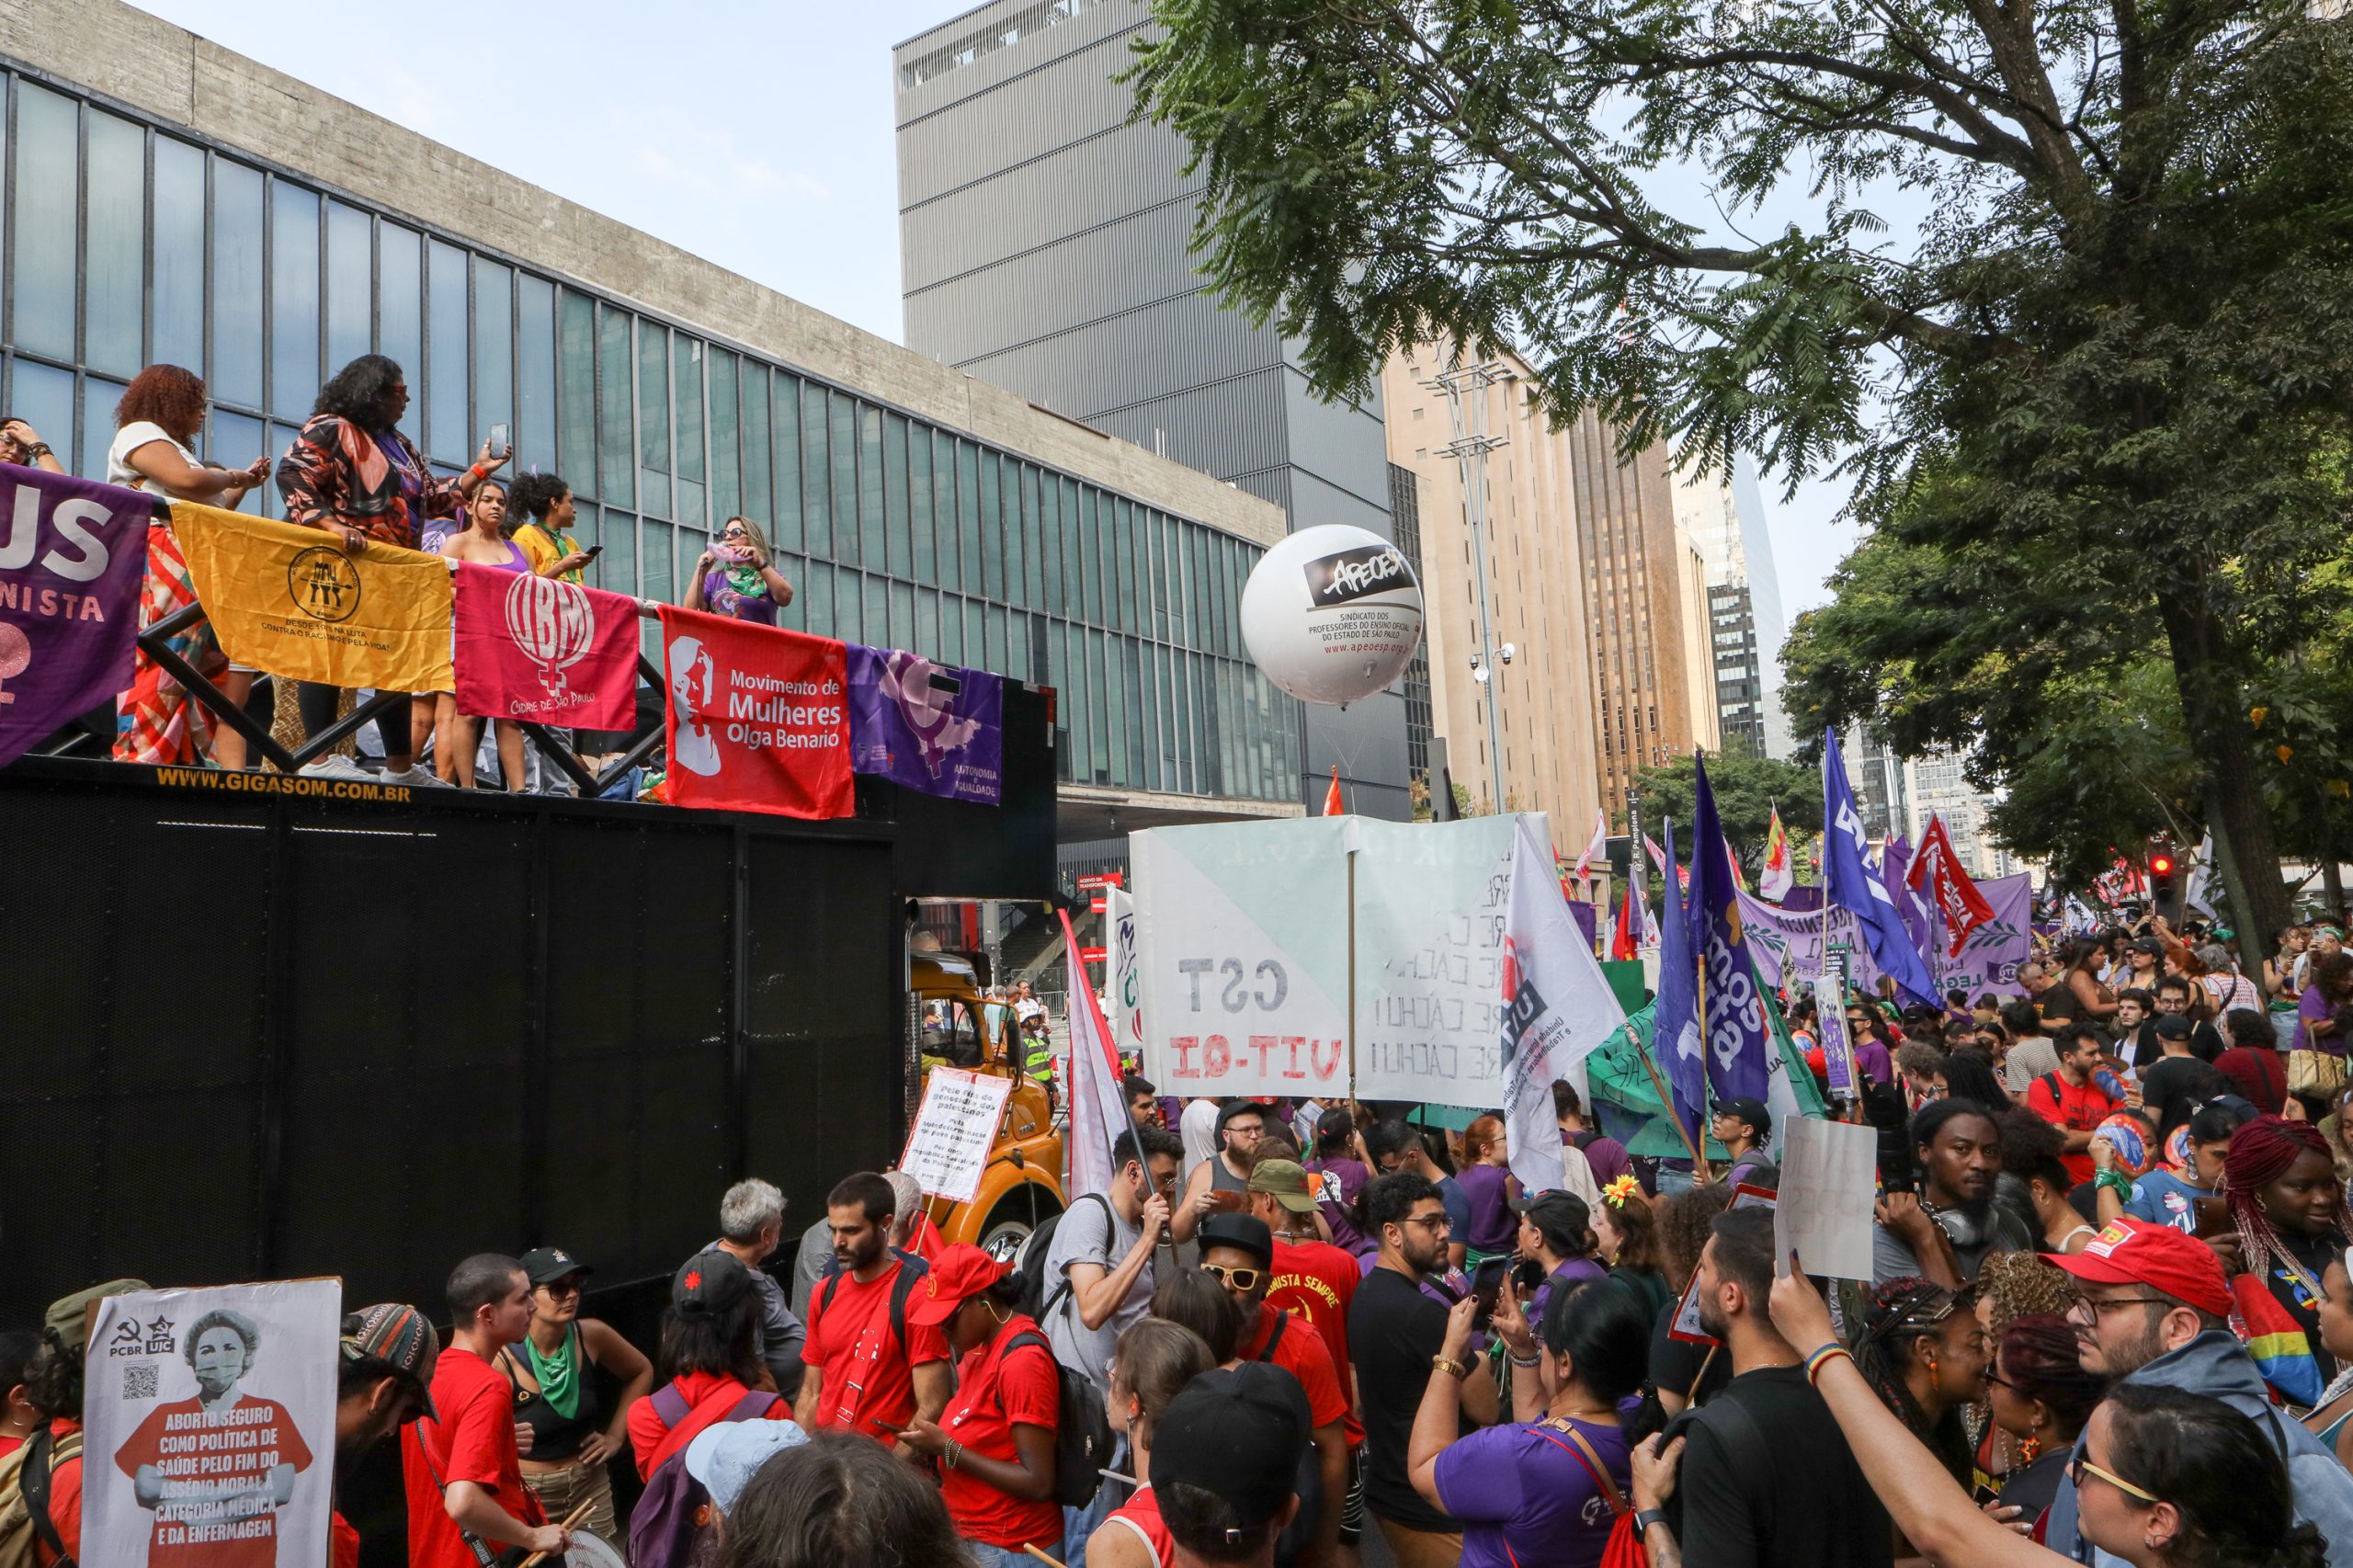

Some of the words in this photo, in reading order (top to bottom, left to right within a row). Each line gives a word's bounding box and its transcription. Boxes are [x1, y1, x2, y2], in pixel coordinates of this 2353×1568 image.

[285, 619, 314, 631] DESDE
[335, 627, 346, 635] NA
[347, 628, 367, 638] LUTA
[511, 574, 585, 660] UBM
[1309, 622, 1358, 634] PROFESSORES
[1359, 621, 1370, 630] DO
[1370, 621, 1392, 631] ENSINO
[1392, 622, 1410, 631] OFICIAL
[1340, 612, 1375, 621] SINDICATO
[1377, 612, 1389, 620] DOS
[261, 622, 296, 636] CONTRA
[347, 638, 369, 648] PELA
[1334, 631, 1360, 641] ESTADO
[1371, 628, 1383, 638] SÃO
[1383, 631, 1400, 639] PAULO
[731, 669, 817, 696] Movimento
[822, 679, 839, 695] de
[540, 699, 552, 710] DE
[571, 691, 596, 707] PAULO
[729, 691, 841, 726] Mulheres
[727, 722, 772, 750] Olga
[777, 729, 839, 749] Benario
[955, 764, 997, 780] AUTONOMIA
[156, 767, 411, 802] WWW.GIGASOM.COM.BR
[956, 780, 996, 797] IGUALDADE
[1631, 810, 1640, 849] Pamplona
[940, 1085, 960, 1096] Pelo
[982, 1094, 993, 1102] do
[938, 1103, 985, 1118] palestinos
[980, 1103, 995, 1111] dos
[949, 1118, 964, 1127] Pela
[1304, 1275, 1340, 1308] SEMPRE
[109, 1346, 142, 1358] PCBR
[150, 1341, 172, 1352] UJC
[165, 1411, 218, 1431] ABORTO
[220, 1406, 273, 1427] SEGURO
[160, 1436, 197, 1453] COMO
[199, 1430, 257, 1451] POLÍTICA
[261, 1428, 278, 1446] DE
[156, 1456, 198, 1477] SAÚDE
[200, 1455, 232, 1473] PELO
[235, 1453, 256, 1471] FIM
[260, 1450, 279, 1469] DO
[160, 1478, 216, 1499] ASSÉDIO
[218, 1475, 262, 1494] MORAL
[155, 1501, 225, 1523] CATEGORIA
[228, 1496, 276, 1517] MÉDICA
[158, 1528, 165, 1545] E
[168, 1527, 185, 1544] DA
[188, 1519, 272, 1544] ENFERMAGEM
